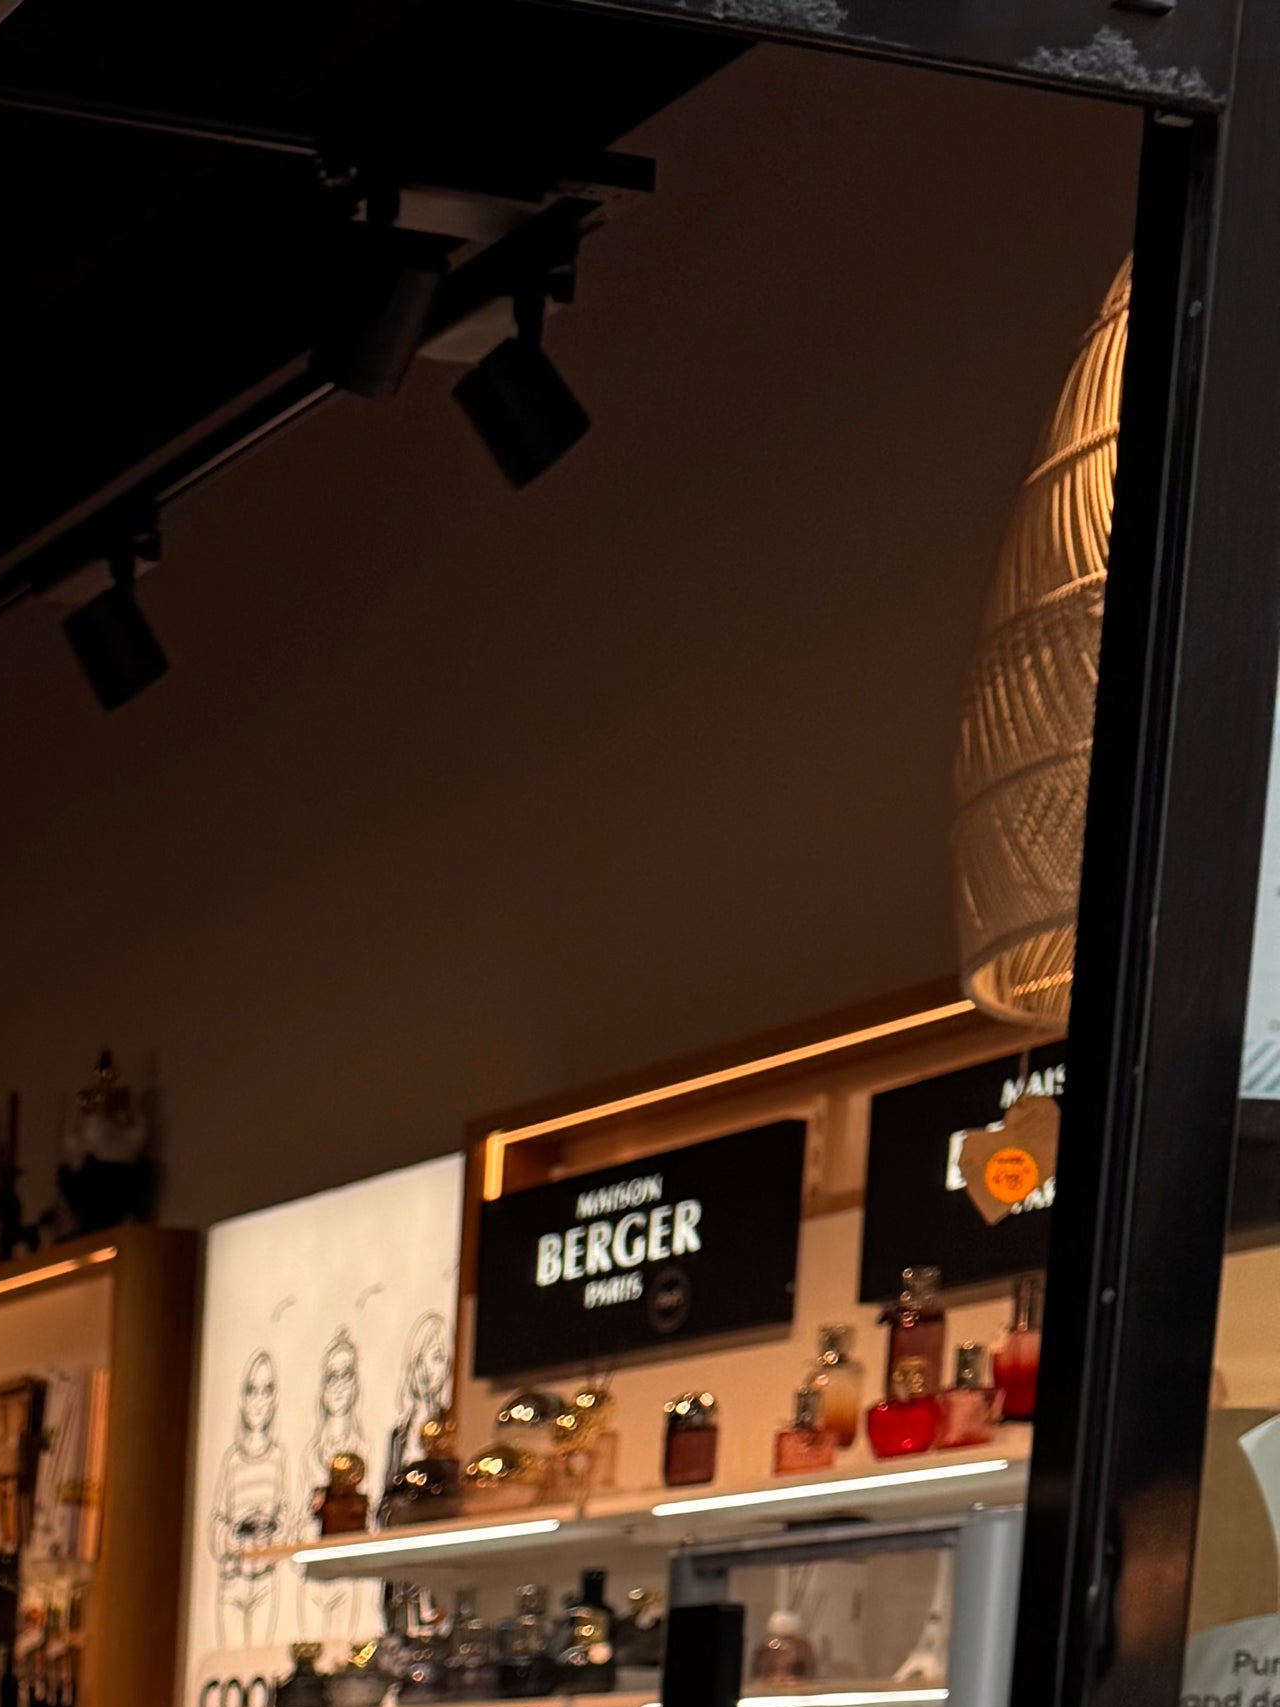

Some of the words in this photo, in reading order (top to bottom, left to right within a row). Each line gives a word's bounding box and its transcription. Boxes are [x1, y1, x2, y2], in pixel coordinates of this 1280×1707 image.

[575, 1172, 665, 1221] MAISON
[536, 1199, 703, 1288] BERGER
[583, 1270, 644, 1310] PARIS
